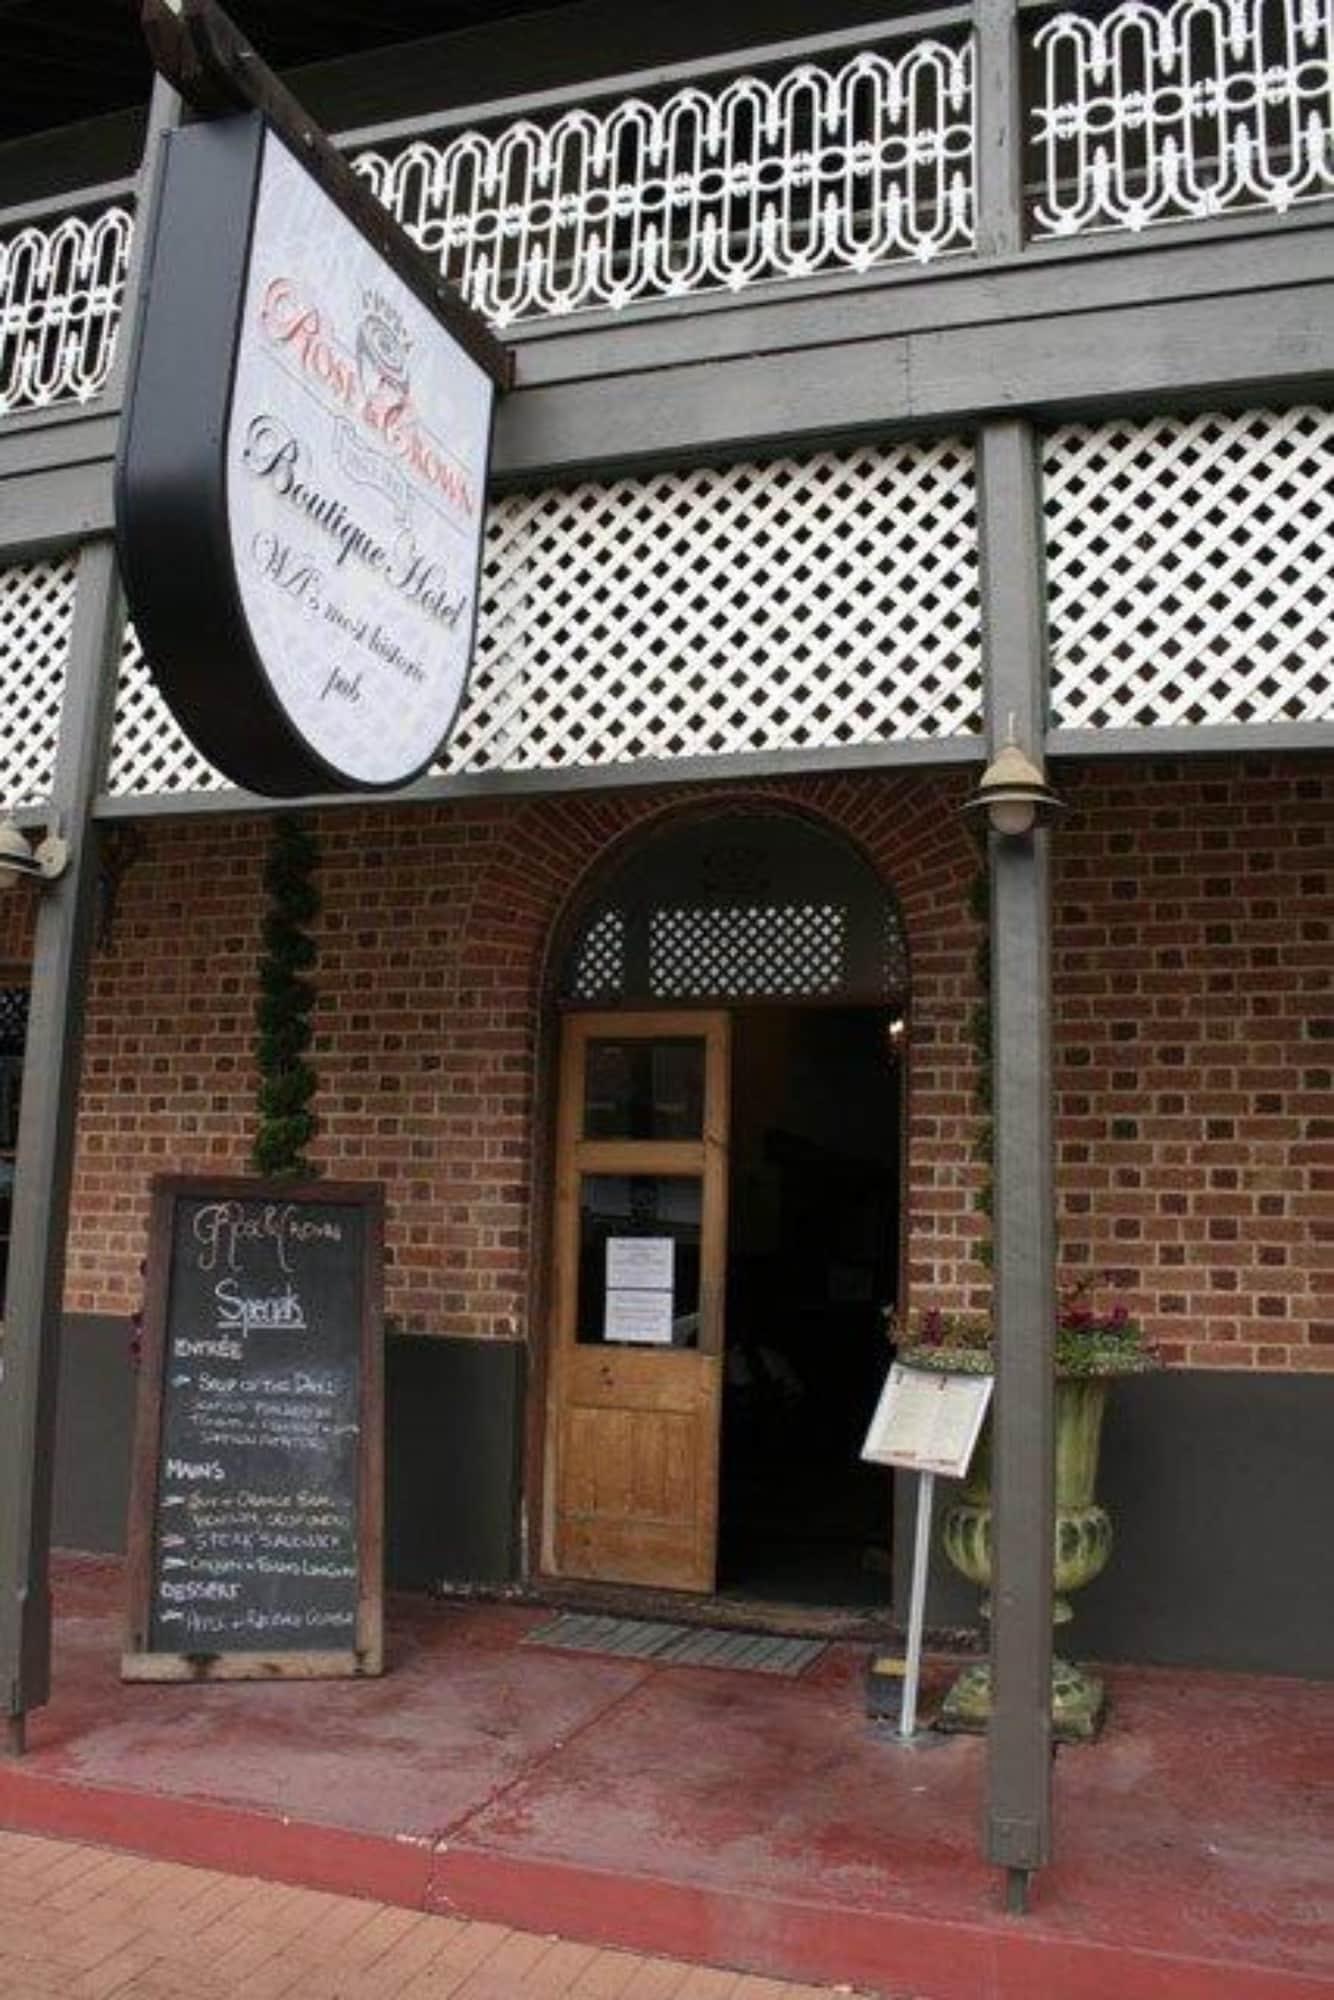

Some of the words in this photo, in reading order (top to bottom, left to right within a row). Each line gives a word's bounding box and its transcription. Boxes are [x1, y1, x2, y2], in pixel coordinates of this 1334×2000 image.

[243, 415, 385, 566] Boutique
[385, 526, 467, 629] Hotel
[323, 601, 369, 641] most
[368, 624, 427, 682] historic
[320, 665, 364, 703] pub
